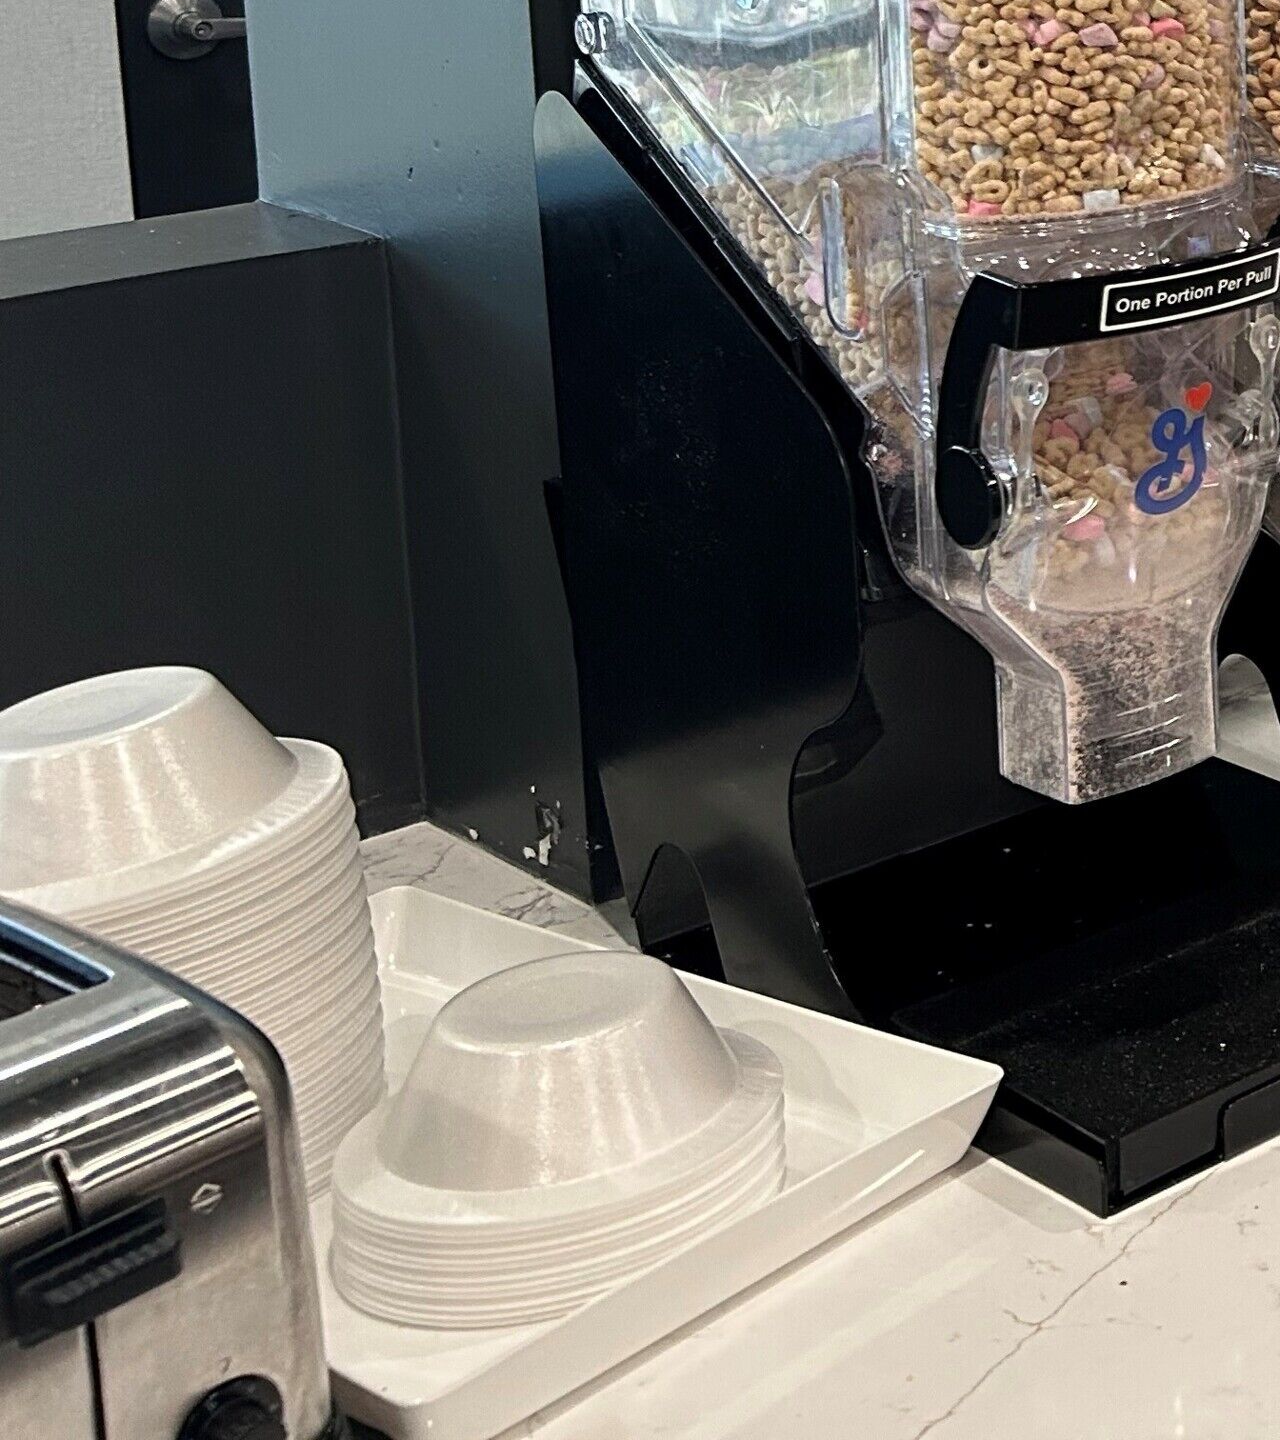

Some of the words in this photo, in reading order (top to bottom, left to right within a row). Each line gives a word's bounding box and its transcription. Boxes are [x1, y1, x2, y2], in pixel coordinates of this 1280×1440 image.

[1115, 298, 1152, 314] One
[1155, 284, 1214, 308] Portion
[1217, 276, 1242, 295] Per
[1245, 265, 1273, 287] Pull
